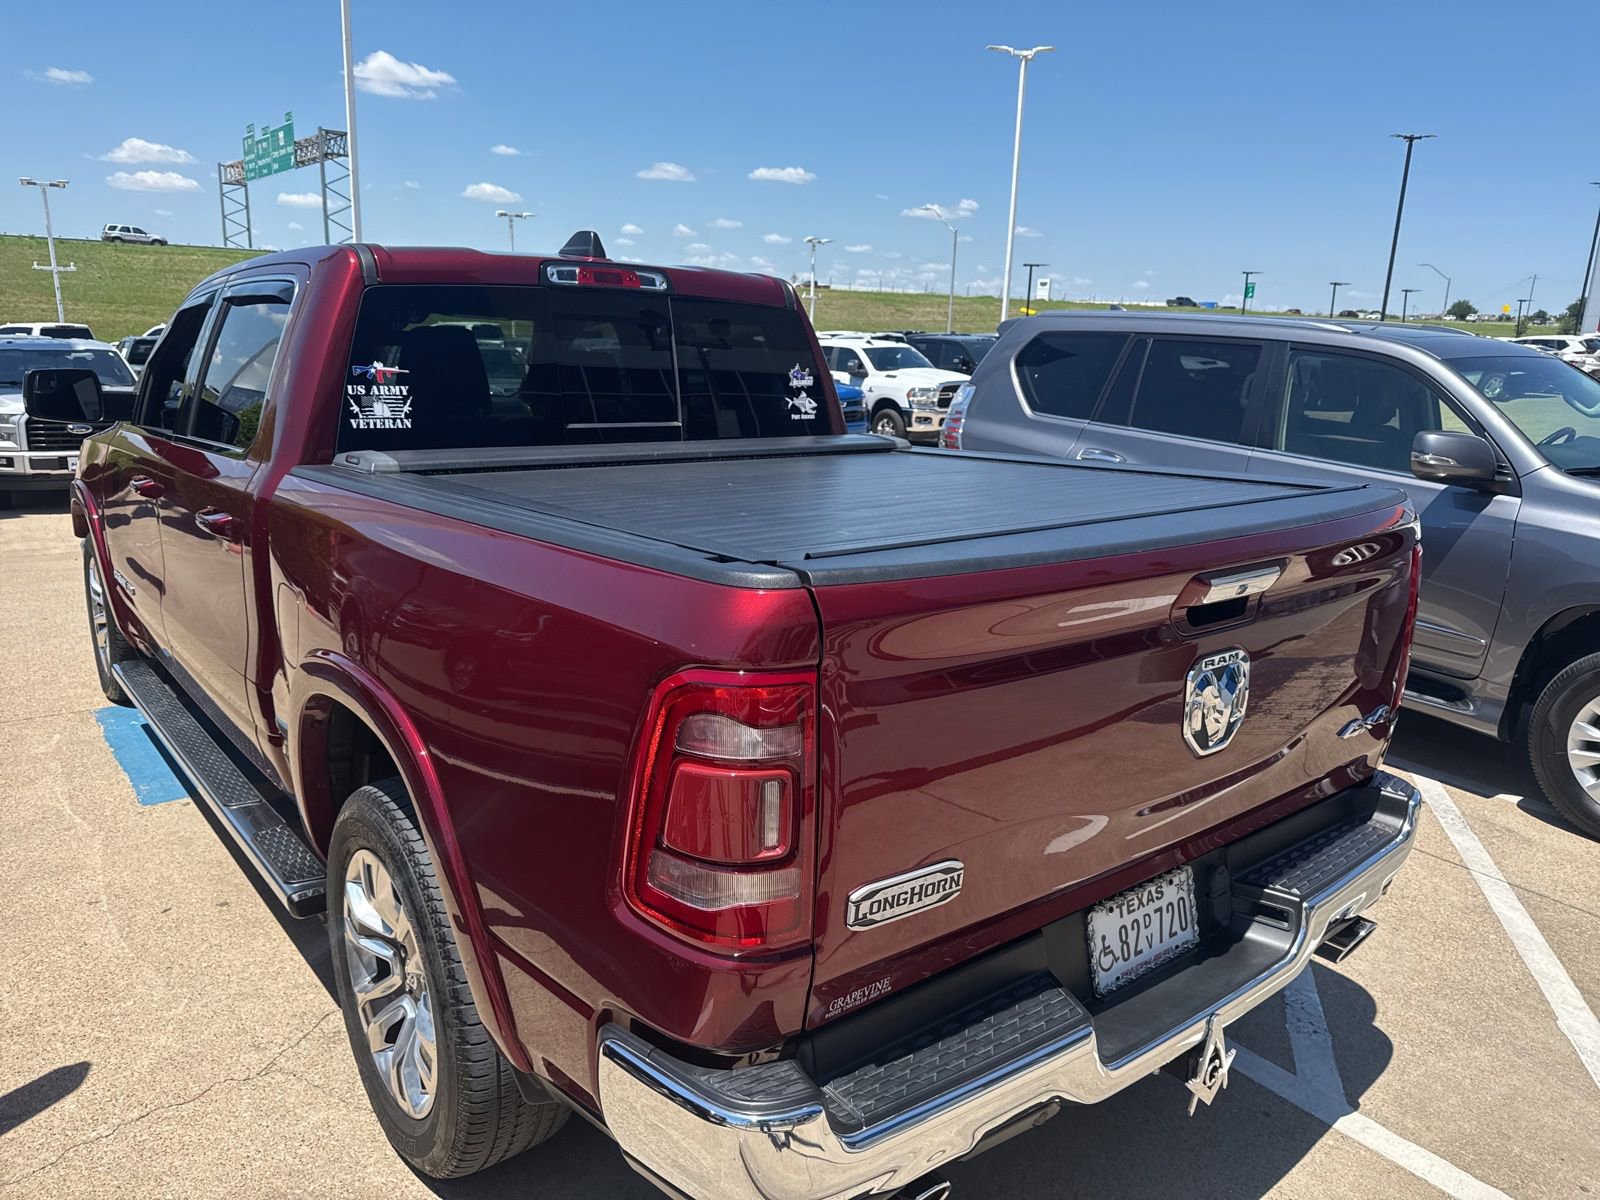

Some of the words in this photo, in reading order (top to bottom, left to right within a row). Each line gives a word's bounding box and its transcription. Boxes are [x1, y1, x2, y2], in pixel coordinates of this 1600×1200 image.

[347, 385, 366, 395] US
[370, 385, 409, 395] ARMY
[350, 419, 412, 429] VETERAN
[1204, 652, 1240, 669] RAM
[852, 872, 963, 923] LONGHORN
[1115, 885, 1165, 918] TEXAS
[829, 976, 891, 1012] GRAPEVINE
